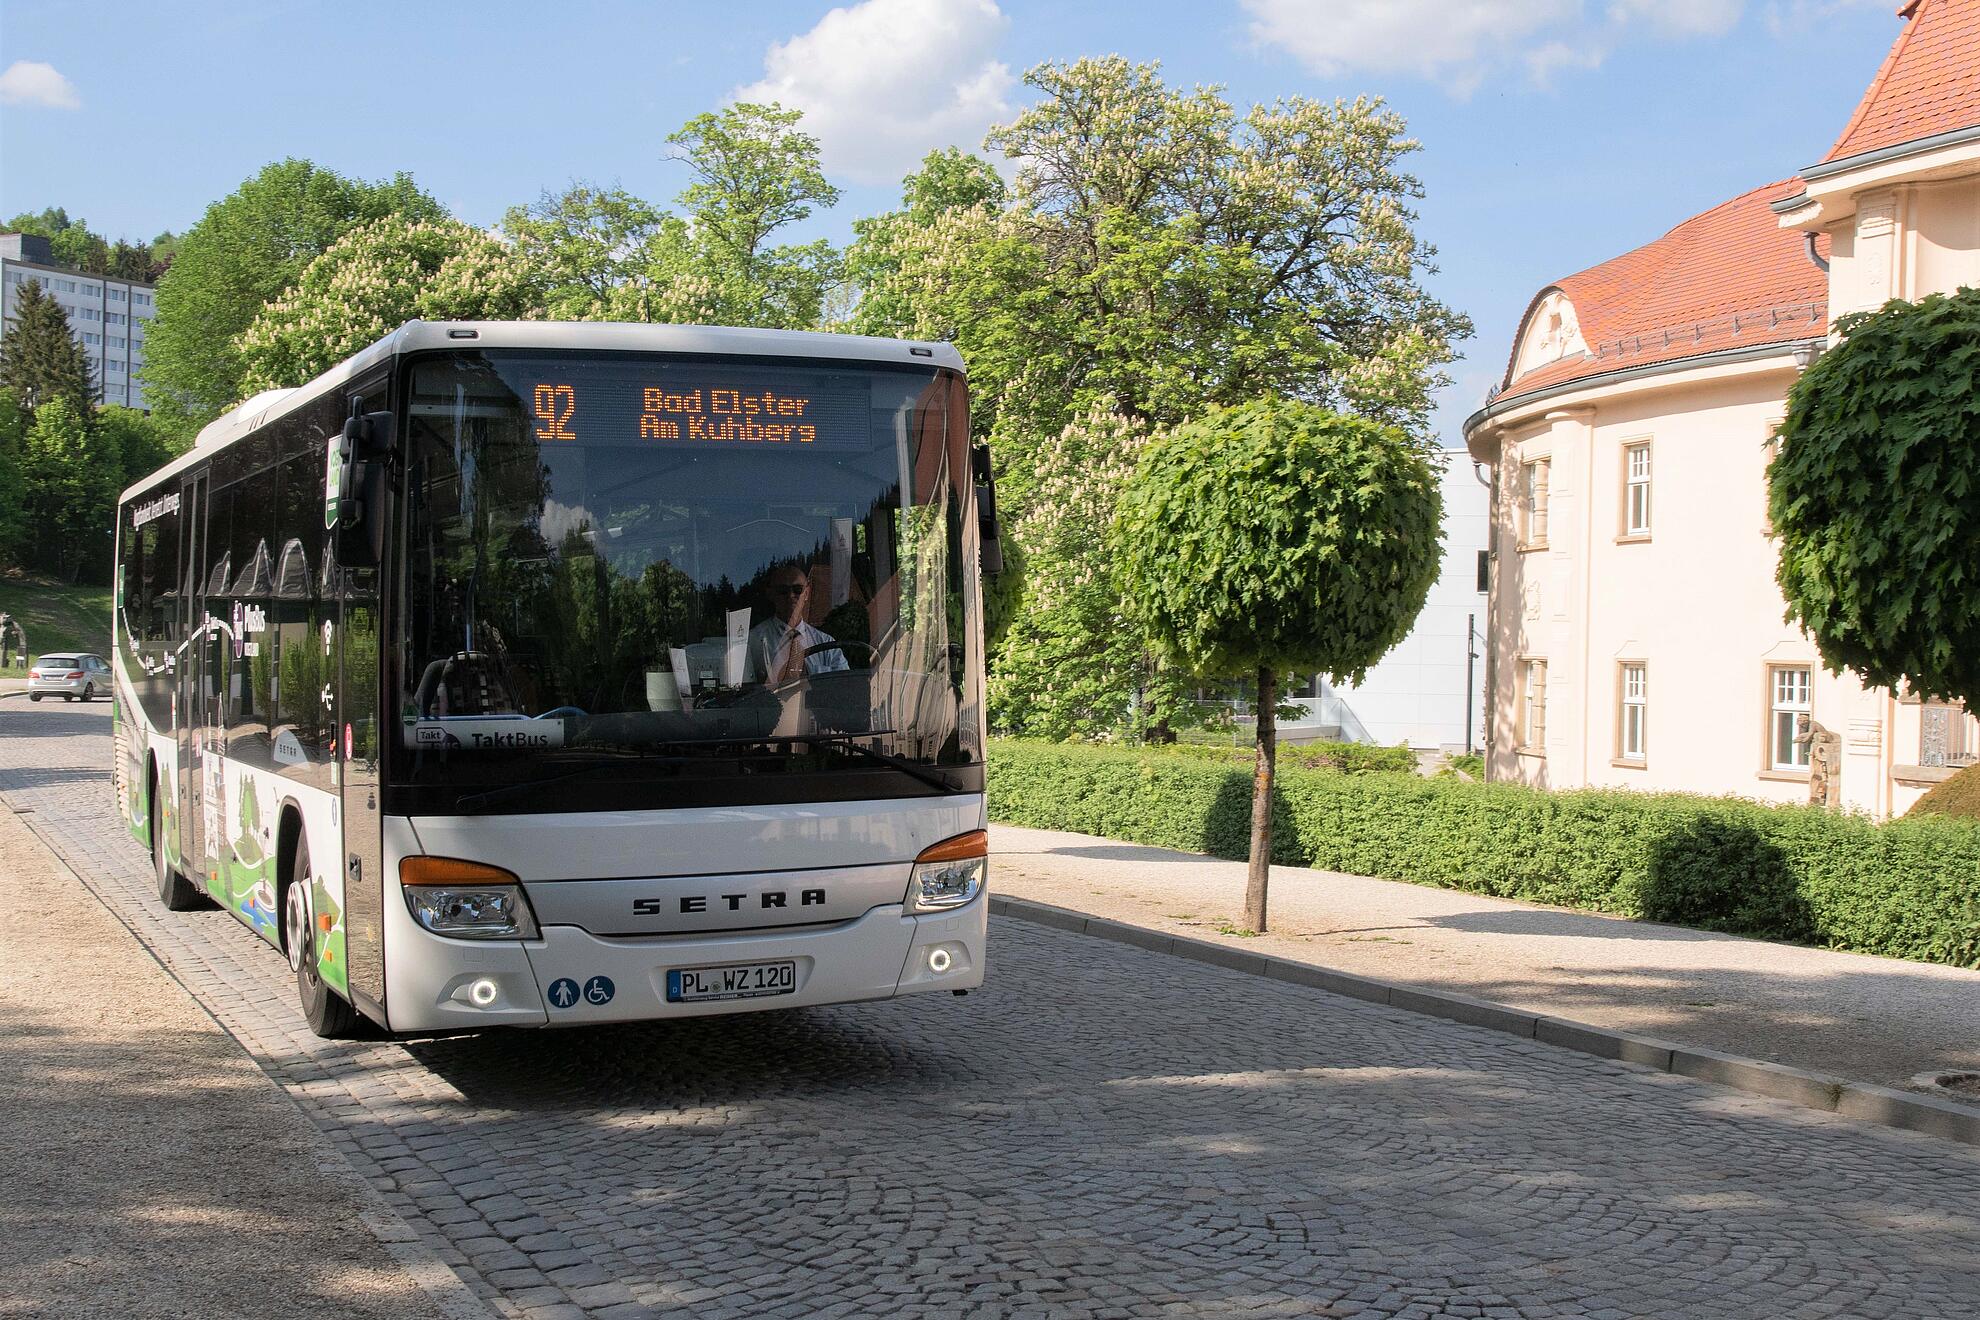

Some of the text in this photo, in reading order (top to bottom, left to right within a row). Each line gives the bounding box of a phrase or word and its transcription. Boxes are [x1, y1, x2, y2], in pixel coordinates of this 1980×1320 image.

[534, 384, 576, 440] 92
[643, 387, 810, 416] Bad Elster
[639, 414, 817, 443] Am Kuhberg
[420, 731, 441, 740] Takt
[471, 731, 549, 748] TaktBus
[632, 887, 827, 916] SETRA
[681, 972, 709, 994] PL
[723, 969, 750, 991] WZ
[754, 966, 792, 989] 120
